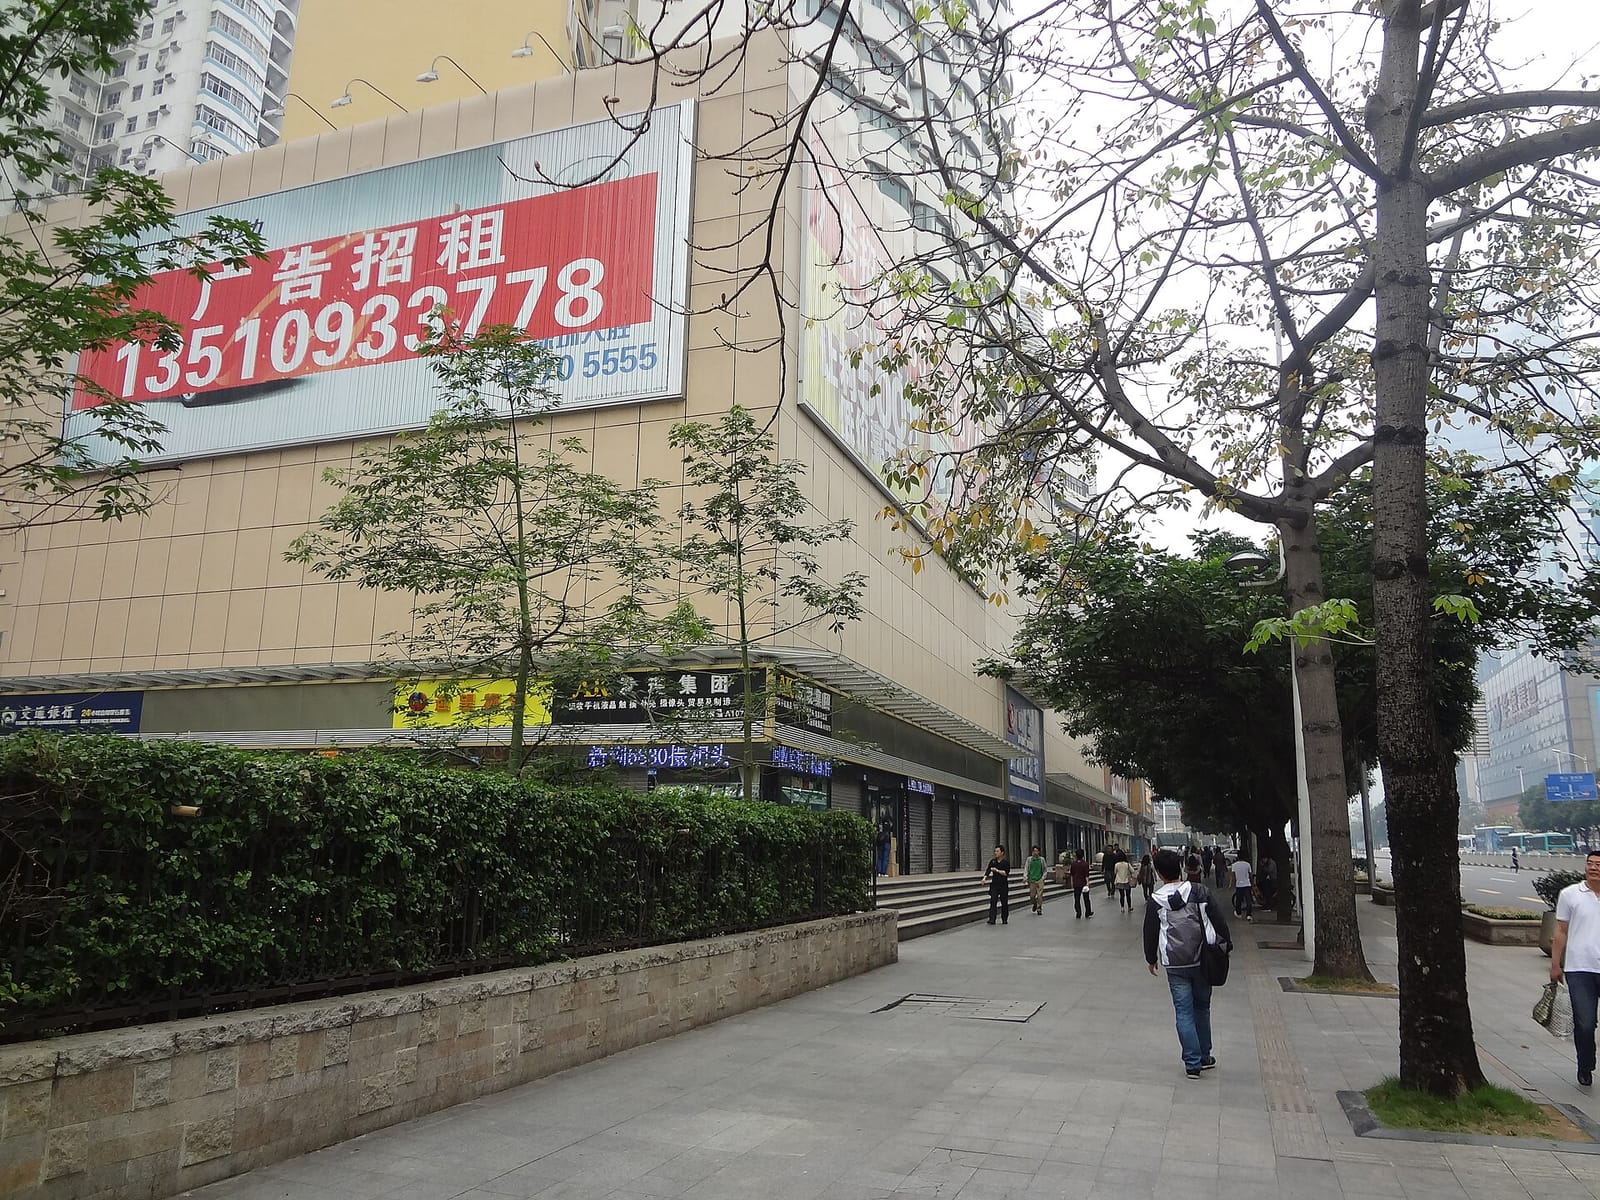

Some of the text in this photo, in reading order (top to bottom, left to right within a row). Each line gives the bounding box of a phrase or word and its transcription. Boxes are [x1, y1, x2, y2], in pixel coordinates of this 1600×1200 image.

[190, 209, 506, 321] 广告招租
[116, 257, 606, 398] 13510933778
[583, 342, 658, 379] 5555
[20, 705, 75, 719] 交通银行
